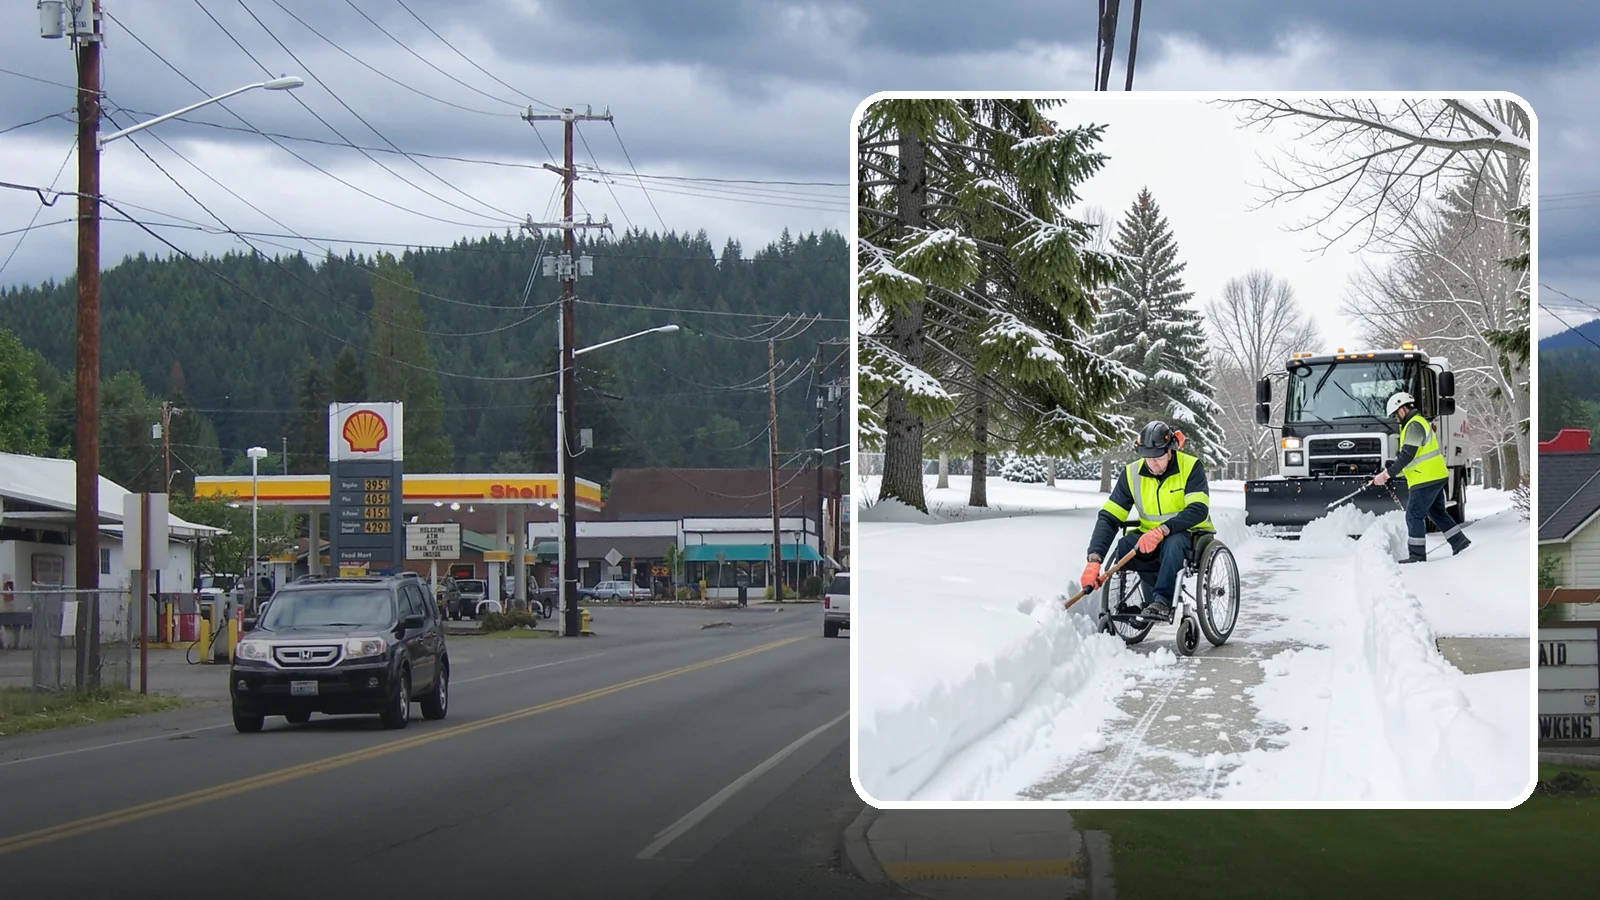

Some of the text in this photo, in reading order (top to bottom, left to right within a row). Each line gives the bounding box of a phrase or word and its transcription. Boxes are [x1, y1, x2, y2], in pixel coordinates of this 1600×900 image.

[366, 480, 383, 490] 395
[490, 484, 547, 499] Shell
[366, 494, 383, 504] 405
[365, 508, 383, 518] 415
[365, 522, 383, 532] 429
[1539, 643, 1566, 665] AID
